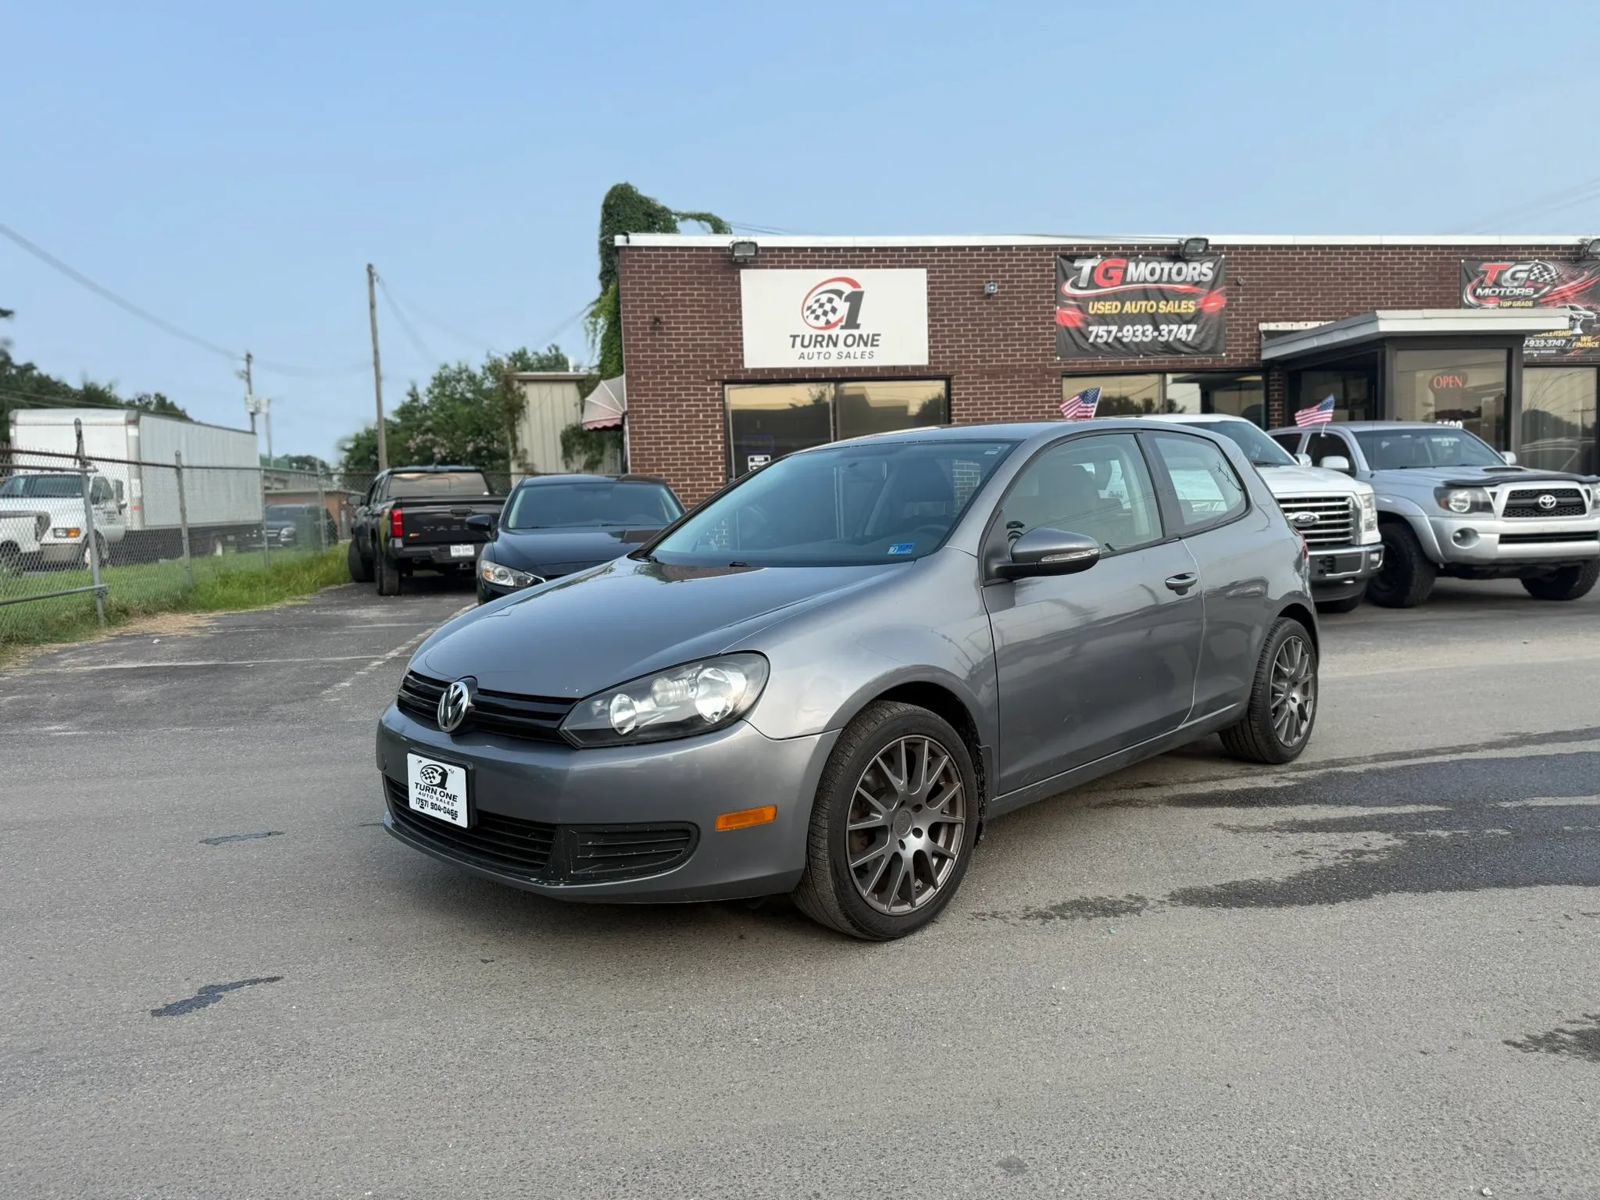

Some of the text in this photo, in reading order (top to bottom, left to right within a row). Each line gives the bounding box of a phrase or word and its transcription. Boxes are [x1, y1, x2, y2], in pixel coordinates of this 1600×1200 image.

[1073, 258, 1214, 288] TG MOTORS
[1480, 262, 1534, 287] TG
[1475, 287, 1535, 297] MOTORS
[839, 290, 865, 330] 1
[1088, 300, 1196, 314] USED AUTO SALES
[789, 333, 882, 349] TURN ONE
[1087, 324, 1197, 343] 757-933-3747
[798, 350, 875, 361] AUTO SALES
[1433, 375, 1463, 389] OPEN
[414, 782, 458, 802] TURN ONE
[418, 792, 455, 807] AUTO SALES
